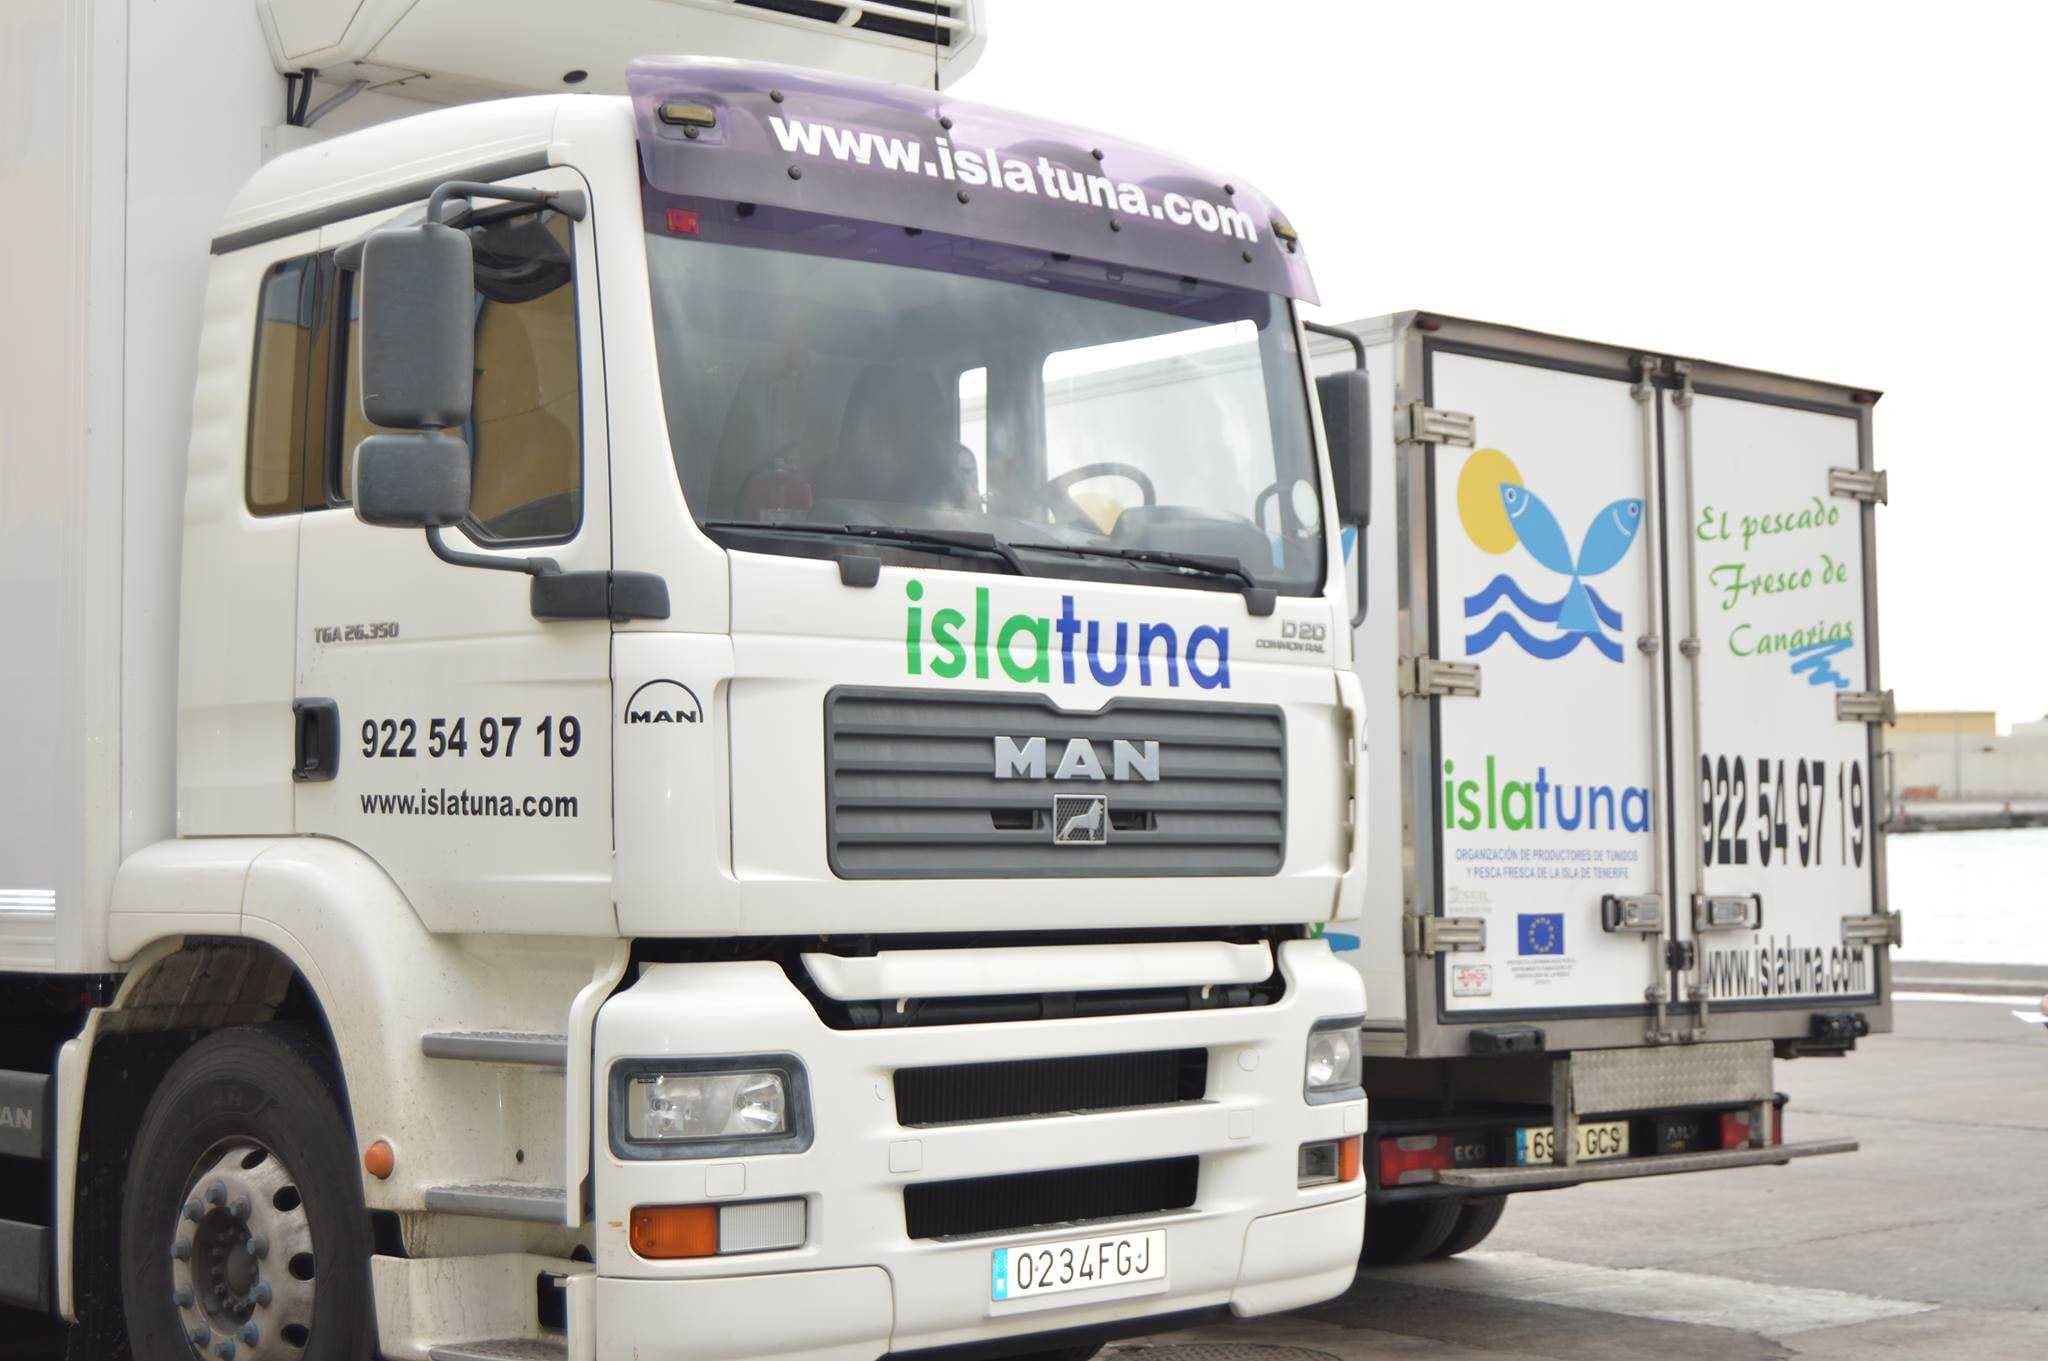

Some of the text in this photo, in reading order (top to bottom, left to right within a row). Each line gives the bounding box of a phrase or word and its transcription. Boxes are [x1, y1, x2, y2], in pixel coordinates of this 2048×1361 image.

[769, 116, 1258, 242] www.islatuna.com
[1696, 496, 1839, 551] El pescado
[1709, 554, 1848, 610] Fresco de
[314, 622, 399, 643] TGA 26.350
[905, 579, 1231, 689] islatuna
[1729, 620, 1854, 657] Canarias
[361, 715, 582, 758] 922 54 97 19
[630, 710, 697, 724] MAN
[994, 736, 1161, 782] MAN
[360, 788, 578, 818] www.islatuna.com
[1444, 755, 1649, 833] islatuna
[1702, 754, 1864, 868] 922 54 97 19
[1455, 845, 1518, 861] ORGANIZACIÓN
[1520, 848, 1531, 861] DE
[1533, 848, 1592, 861] PRODUCTORES
[1593, 849, 1604, 861] DE
[1466, 867, 1629, 879] Y PESCA FRESCA DE LA ISLA DE TENERIFE
[1586, 1126, 1621, 1155] GCS
